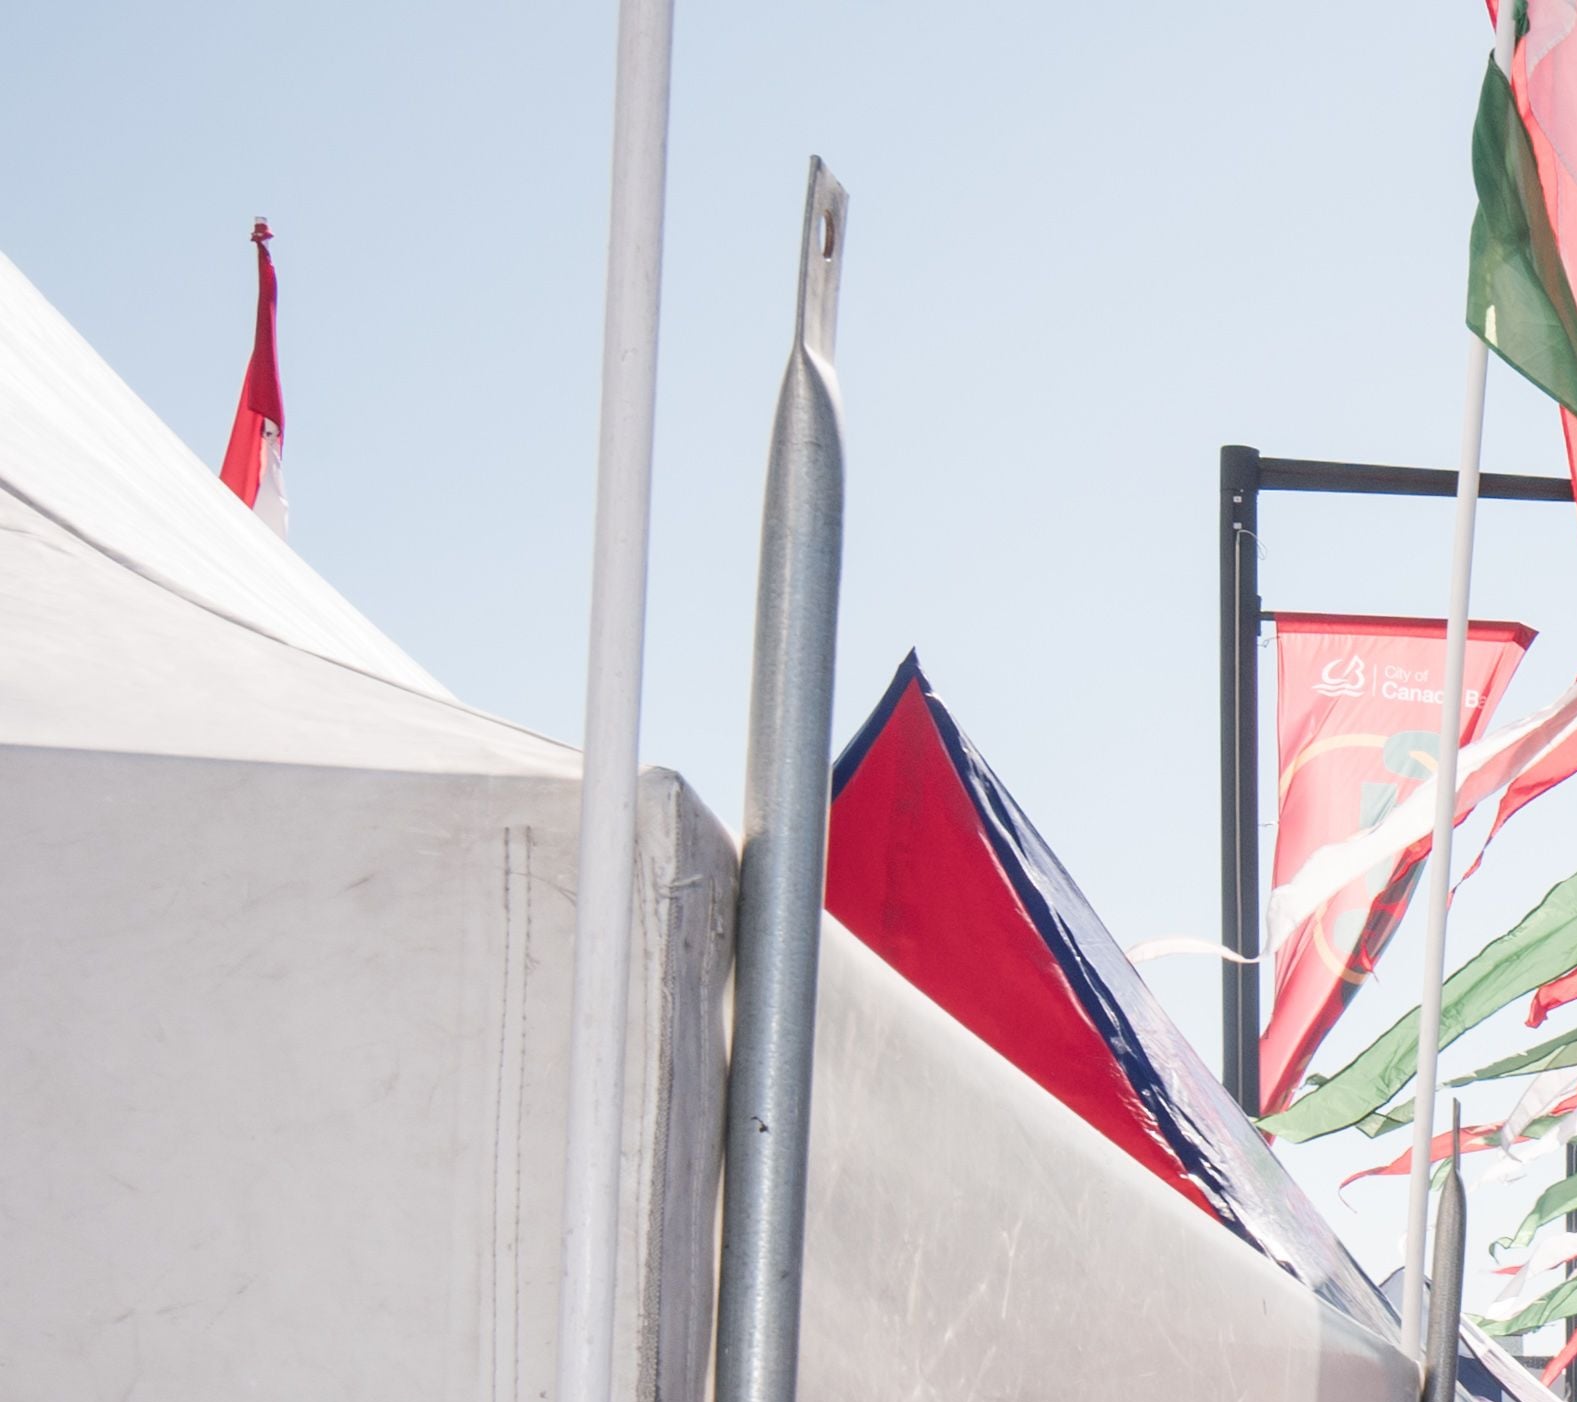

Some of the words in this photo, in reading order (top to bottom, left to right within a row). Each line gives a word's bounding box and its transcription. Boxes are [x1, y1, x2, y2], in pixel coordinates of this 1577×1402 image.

[1384, 664, 1411, 681] City
[1415, 669, 1429, 681] of
[1381, 683, 1447, 705] Cana
